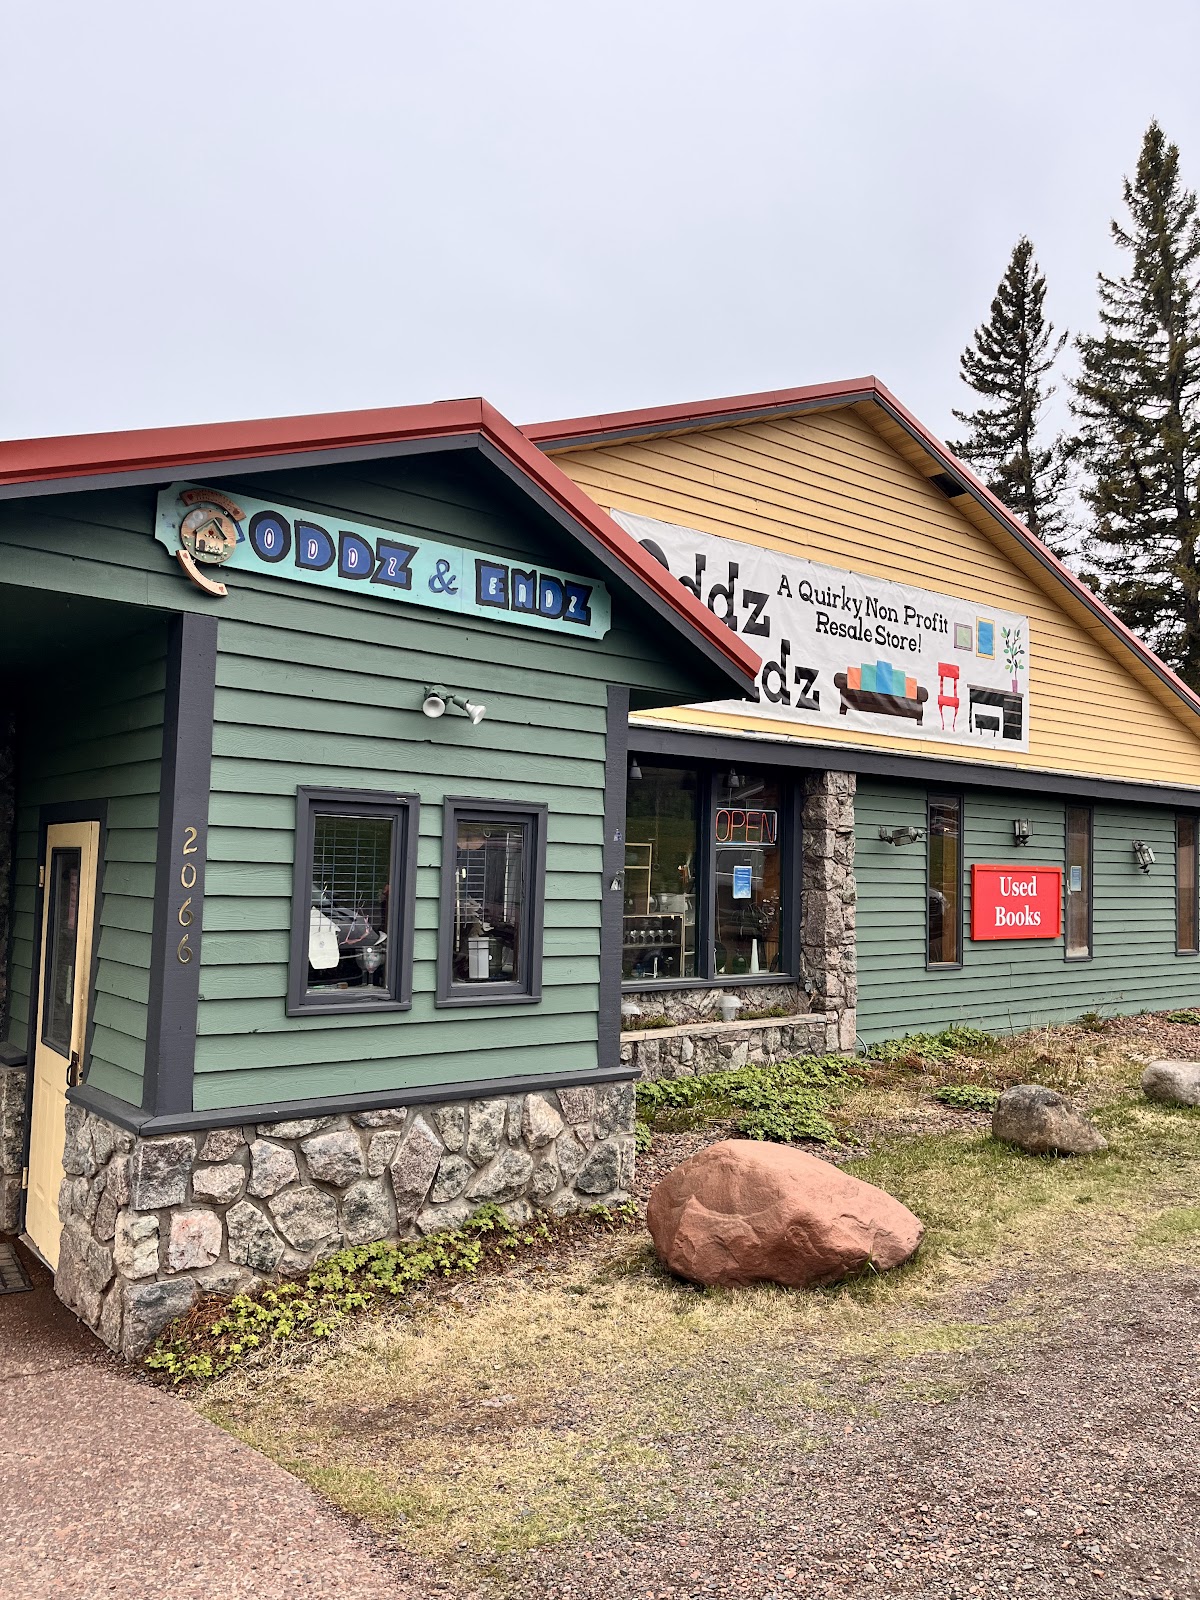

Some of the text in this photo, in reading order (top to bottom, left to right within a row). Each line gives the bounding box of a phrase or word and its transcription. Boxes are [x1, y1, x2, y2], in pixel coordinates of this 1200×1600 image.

[249, 510, 419, 590] ODDZ
[428, 559, 459, 596] &
[638, 539, 771, 638] ddz
[777, 574, 948, 634] A Quirky Non Profit
[815, 611, 922, 653] Resale Store!
[715, 810, 776, 844] OPEN
[177, 827, 198, 964] 2066
[999, 876, 1038, 897] Used
[994, 905, 1041, 927] Books
